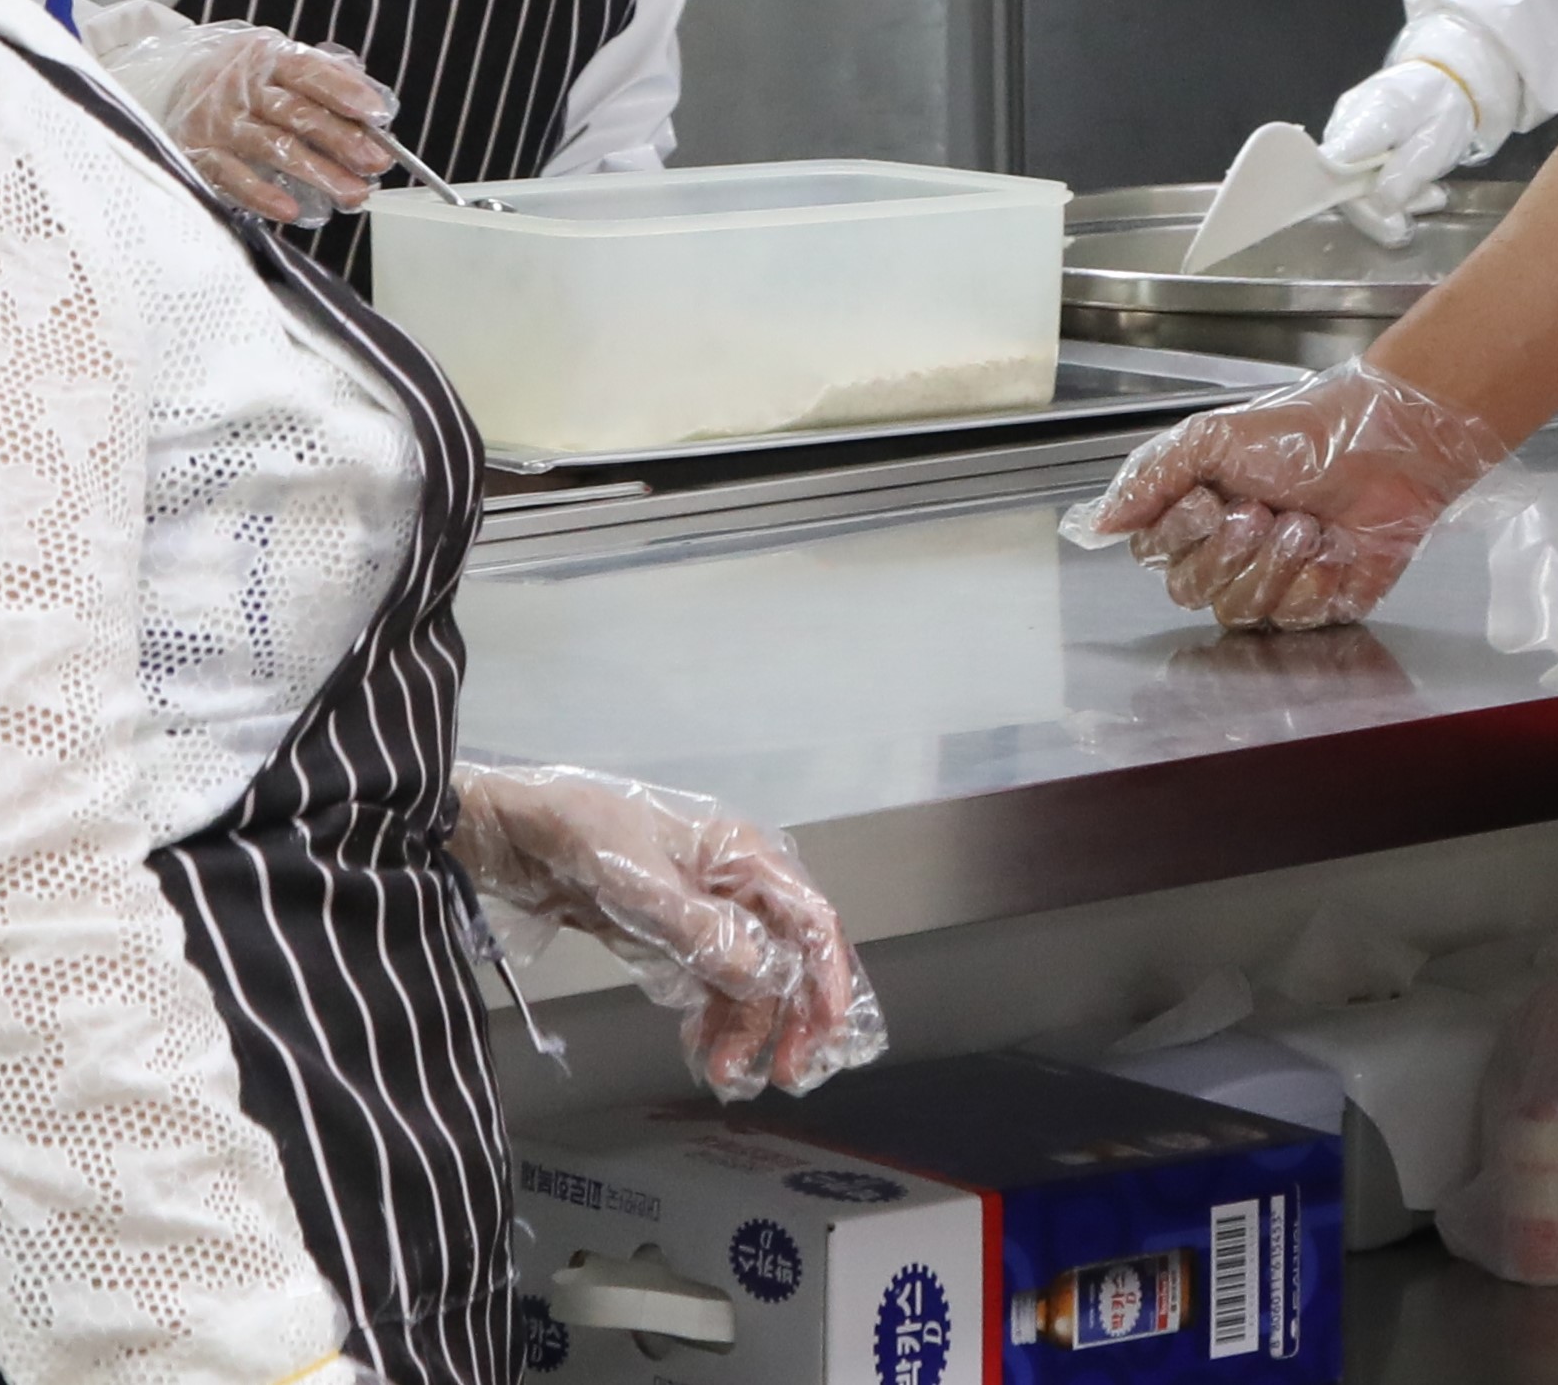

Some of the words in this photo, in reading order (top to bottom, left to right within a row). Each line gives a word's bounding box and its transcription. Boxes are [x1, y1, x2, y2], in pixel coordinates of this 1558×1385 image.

[521, 1160, 603, 1210] 피로회복제
[760, 1229, 774, 1249] D
[738, 1243, 793, 1286] 박카스
[922, 1319, 943, 1346] D
